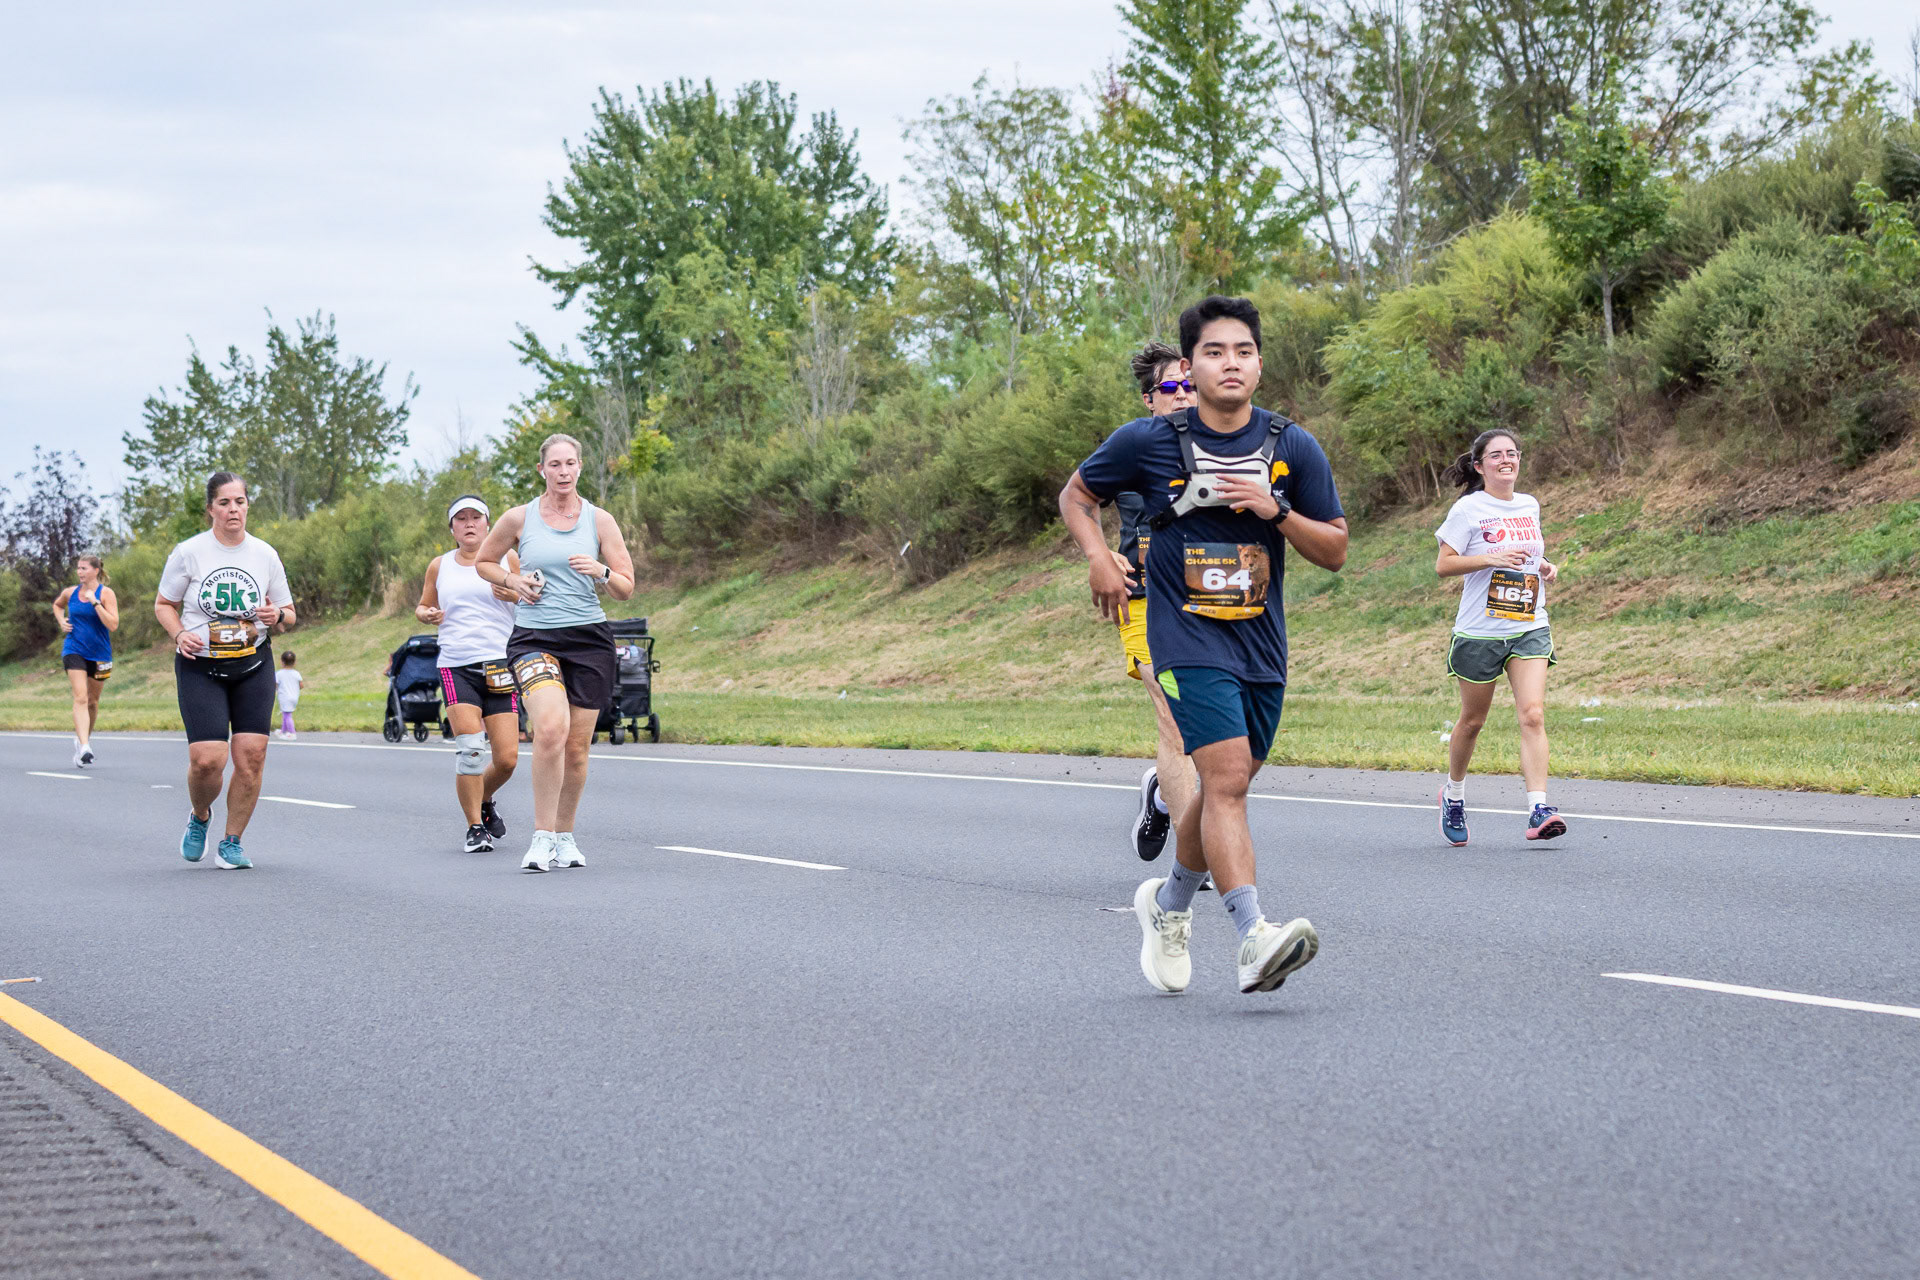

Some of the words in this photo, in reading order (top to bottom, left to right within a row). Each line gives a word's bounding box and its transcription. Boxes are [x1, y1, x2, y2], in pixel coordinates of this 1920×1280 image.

[1503, 516, 1536, 529] STRIDE
[205, 570, 254, 590] Morristown
[1202, 568, 1253, 591] 64
[215, 582, 247, 612] 5k
[1495, 585, 1534, 604] 162
[219, 630, 249, 643] 54
[491, 672, 515, 687] 12
[520, 662, 560, 683] 273
